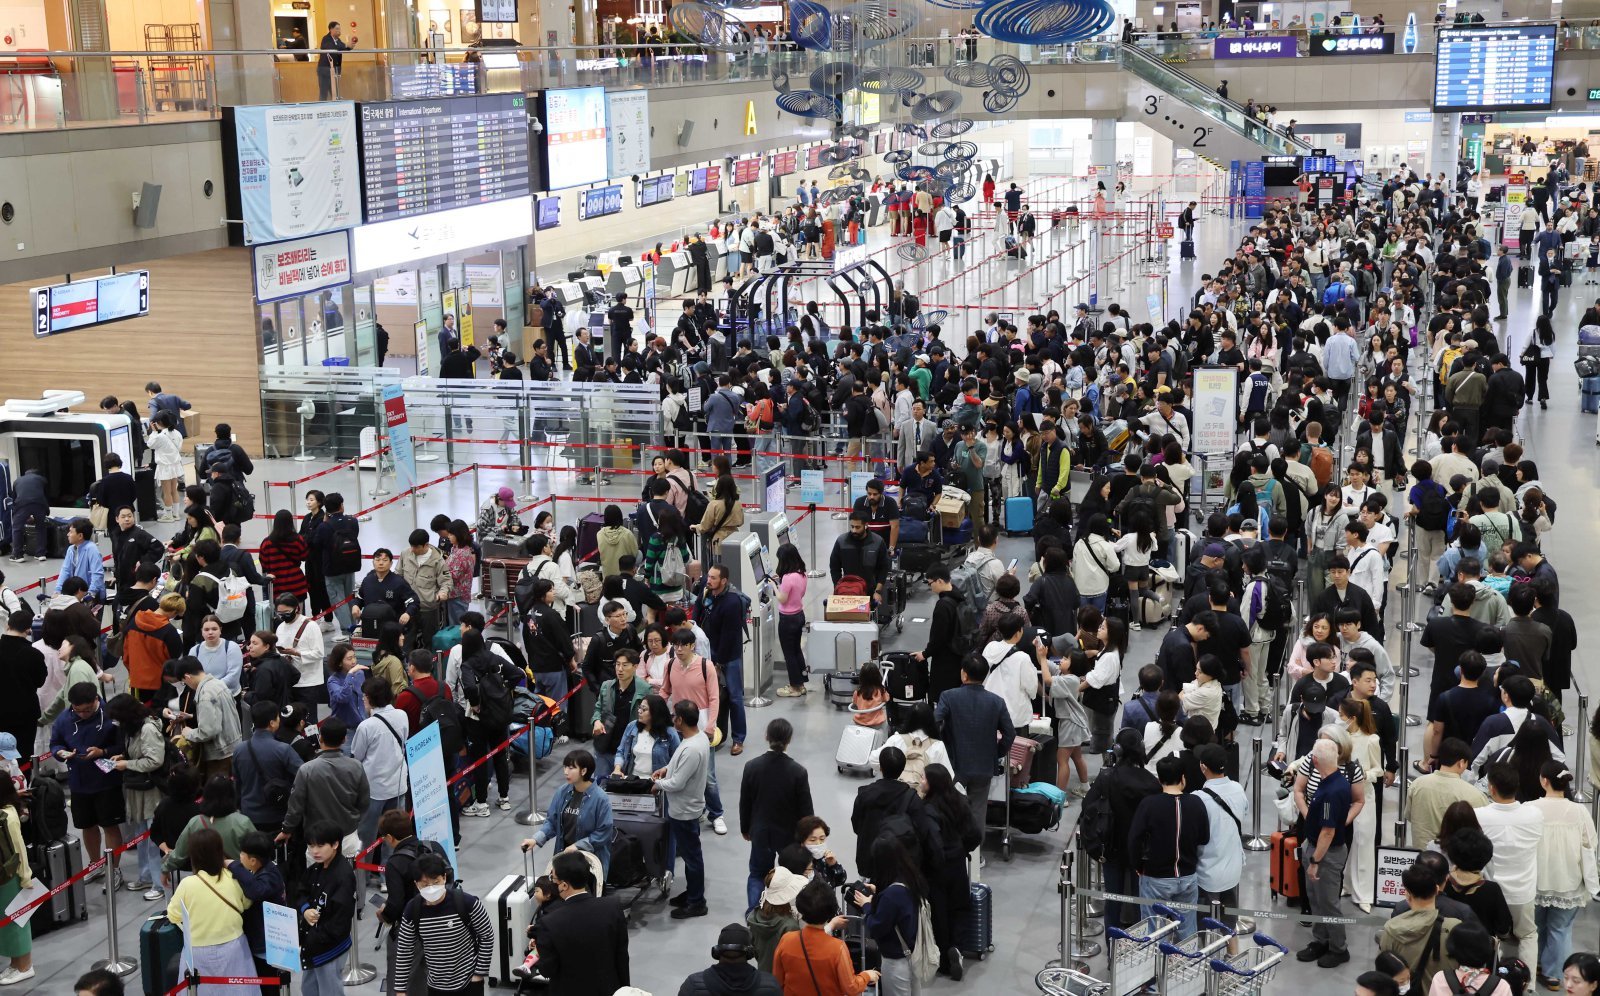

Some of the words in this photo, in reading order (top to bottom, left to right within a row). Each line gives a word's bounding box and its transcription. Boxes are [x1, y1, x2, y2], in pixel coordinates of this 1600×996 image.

[1243, 41, 1281, 53] 하나투어
[1336, 38, 1383, 51] 모두투어
[1145, 95, 1164, 115] 3F
[370, 108, 384, 119] 국제선
[384, 108, 394, 118] 출발
[398, 106, 422, 116] International
[423, 106, 442, 116] Departures
[744, 100, 758, 136] A
[1193, 127, 1214, 147] 2F
[278, 247, 317, 267] 보조배터리는
[278, 268, 306, 285] 비닐팩에
[306, 265, 320, 280] 넣어
[321, 262, 334, 277] 손에
[334, 258, 347, 273] 휴대
[140, 276, 147, 290] B
[38, 294, 47, 309] B
[141, 294, 146, 308] 1
[40, 314, 46, 329] 2
[388, 413, 405, 422] PRIORITY
[414, 736, 432, 751] KOREAN
[1384, 856, 1415, 865] 일반승객
[1382, 887, 1397, 895] 부터
